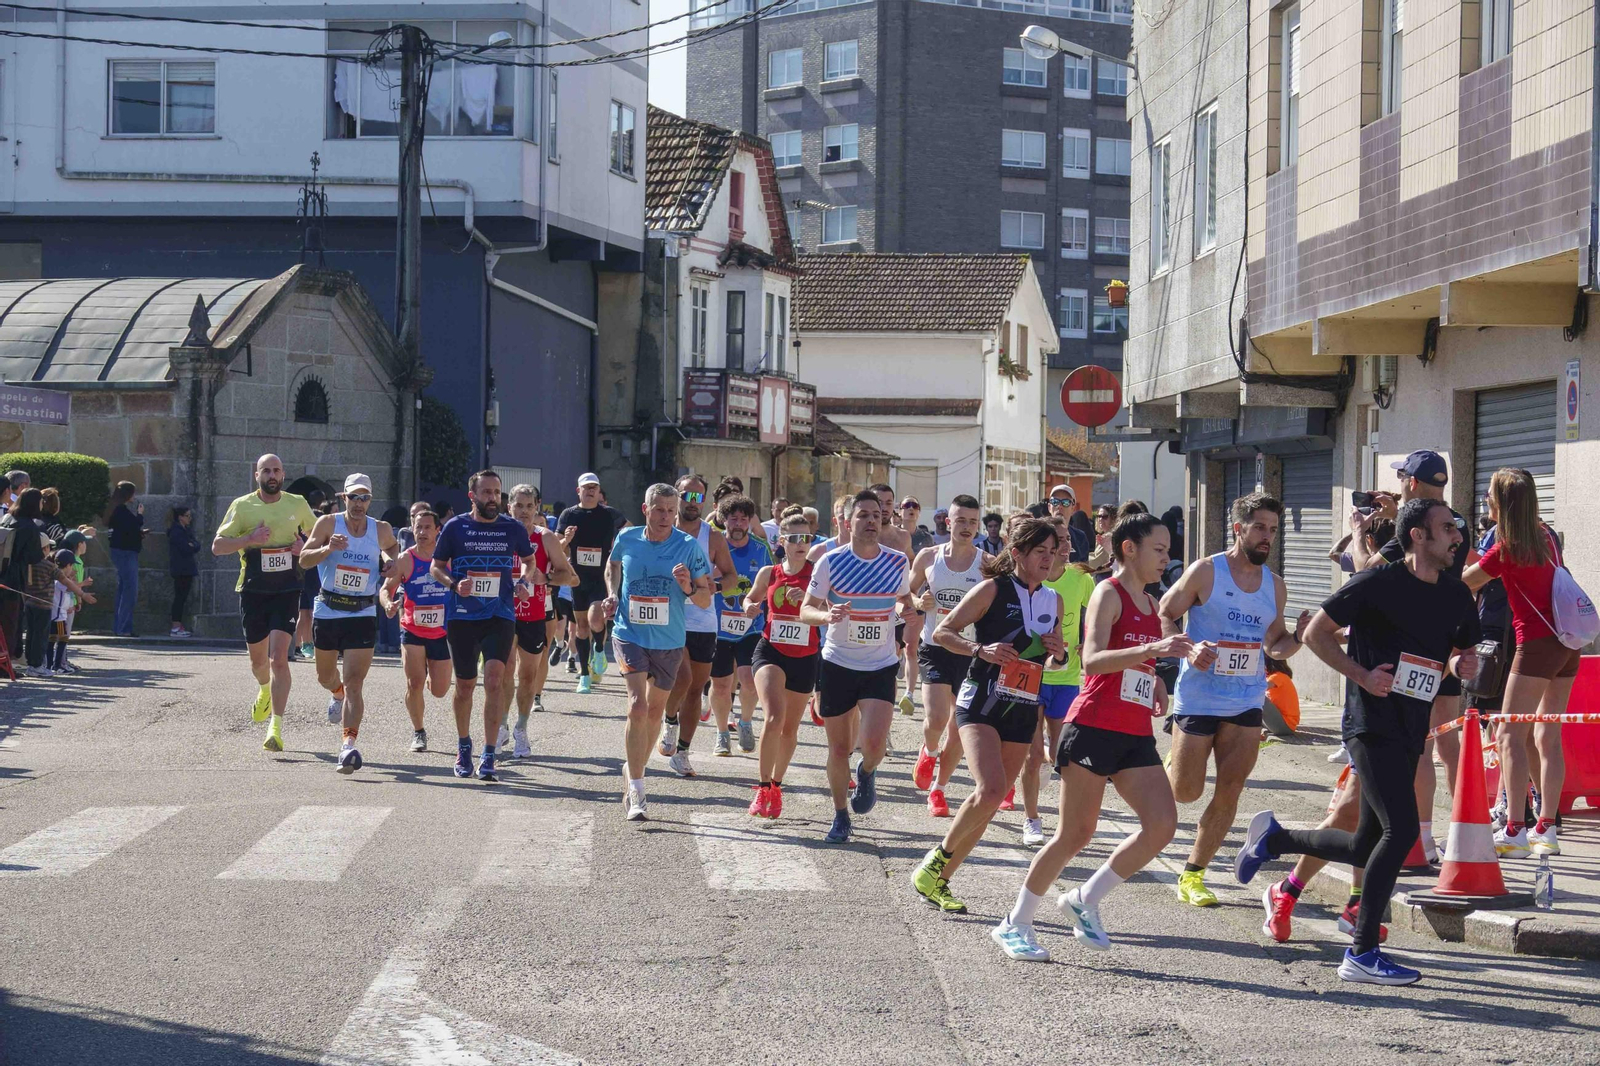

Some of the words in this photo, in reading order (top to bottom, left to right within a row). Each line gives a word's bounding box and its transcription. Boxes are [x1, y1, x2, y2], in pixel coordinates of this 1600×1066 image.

[0, 393, 27, 402] apela
[32, 395, 44, 403] de
[2, 404, 63, 420] Sebastian
[269, 556, 286, 568] 884
[583, 554, 595, 563] 741
[342, 574, 361, 587] 626
[475, 580, 492, 592] 617
[938, 593, 963, 603] GLOB
[421, 613, 438, 623] 292
[639, 606, 658, 620] 601
[728, 619, 746, 631] 476
[779, 625, 801, 640] 202
[858, 625, 881, 640] 386
[1124, 632, 1147, 642] ALEX
[1229, 653, 1249, 670] 512
[1016, 673, 1029, 691] 21
[1135, 677, 1150, 699] 413
[1406, 670, 1435, 693] 879
